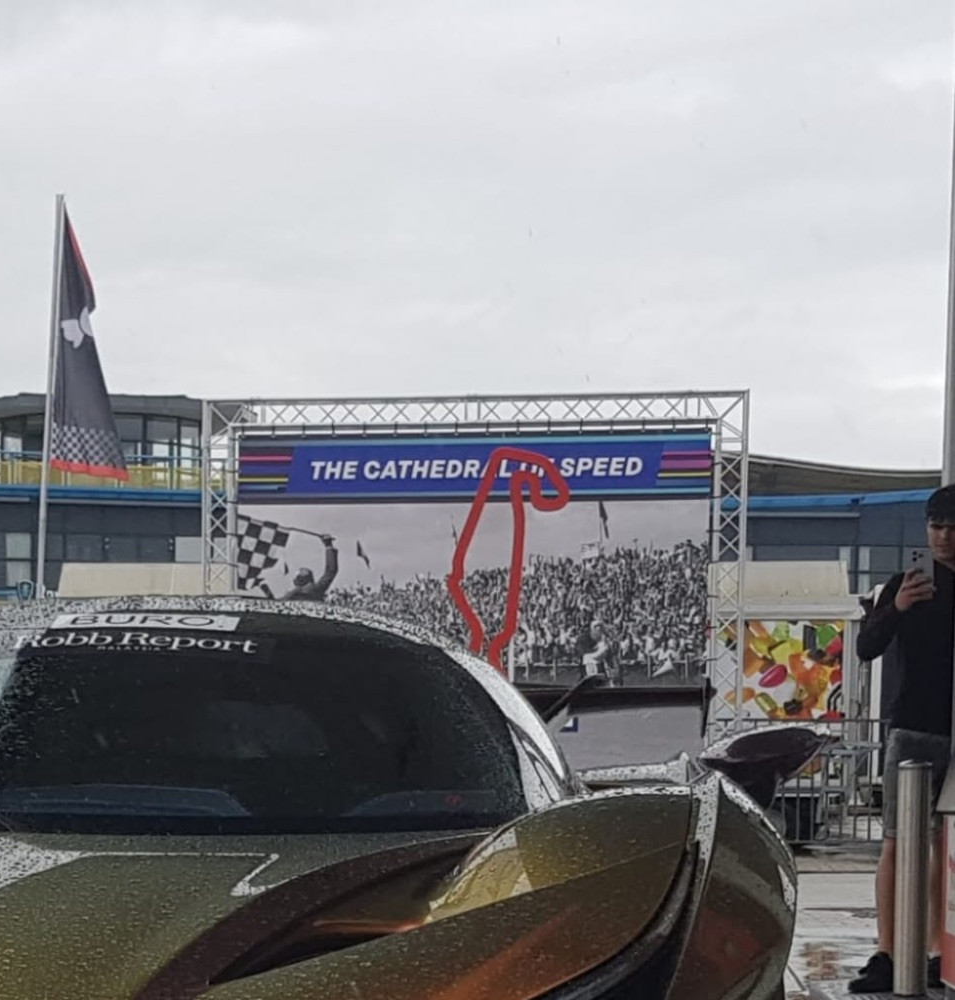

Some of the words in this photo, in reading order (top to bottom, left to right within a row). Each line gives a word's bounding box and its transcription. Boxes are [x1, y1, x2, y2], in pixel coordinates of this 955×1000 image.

[310, 460, 359, 480] THE
[559, 456, 643, 478] SPEED
[13, 632, 113, 650] Robb
[118, 632, 258, 654] Report
